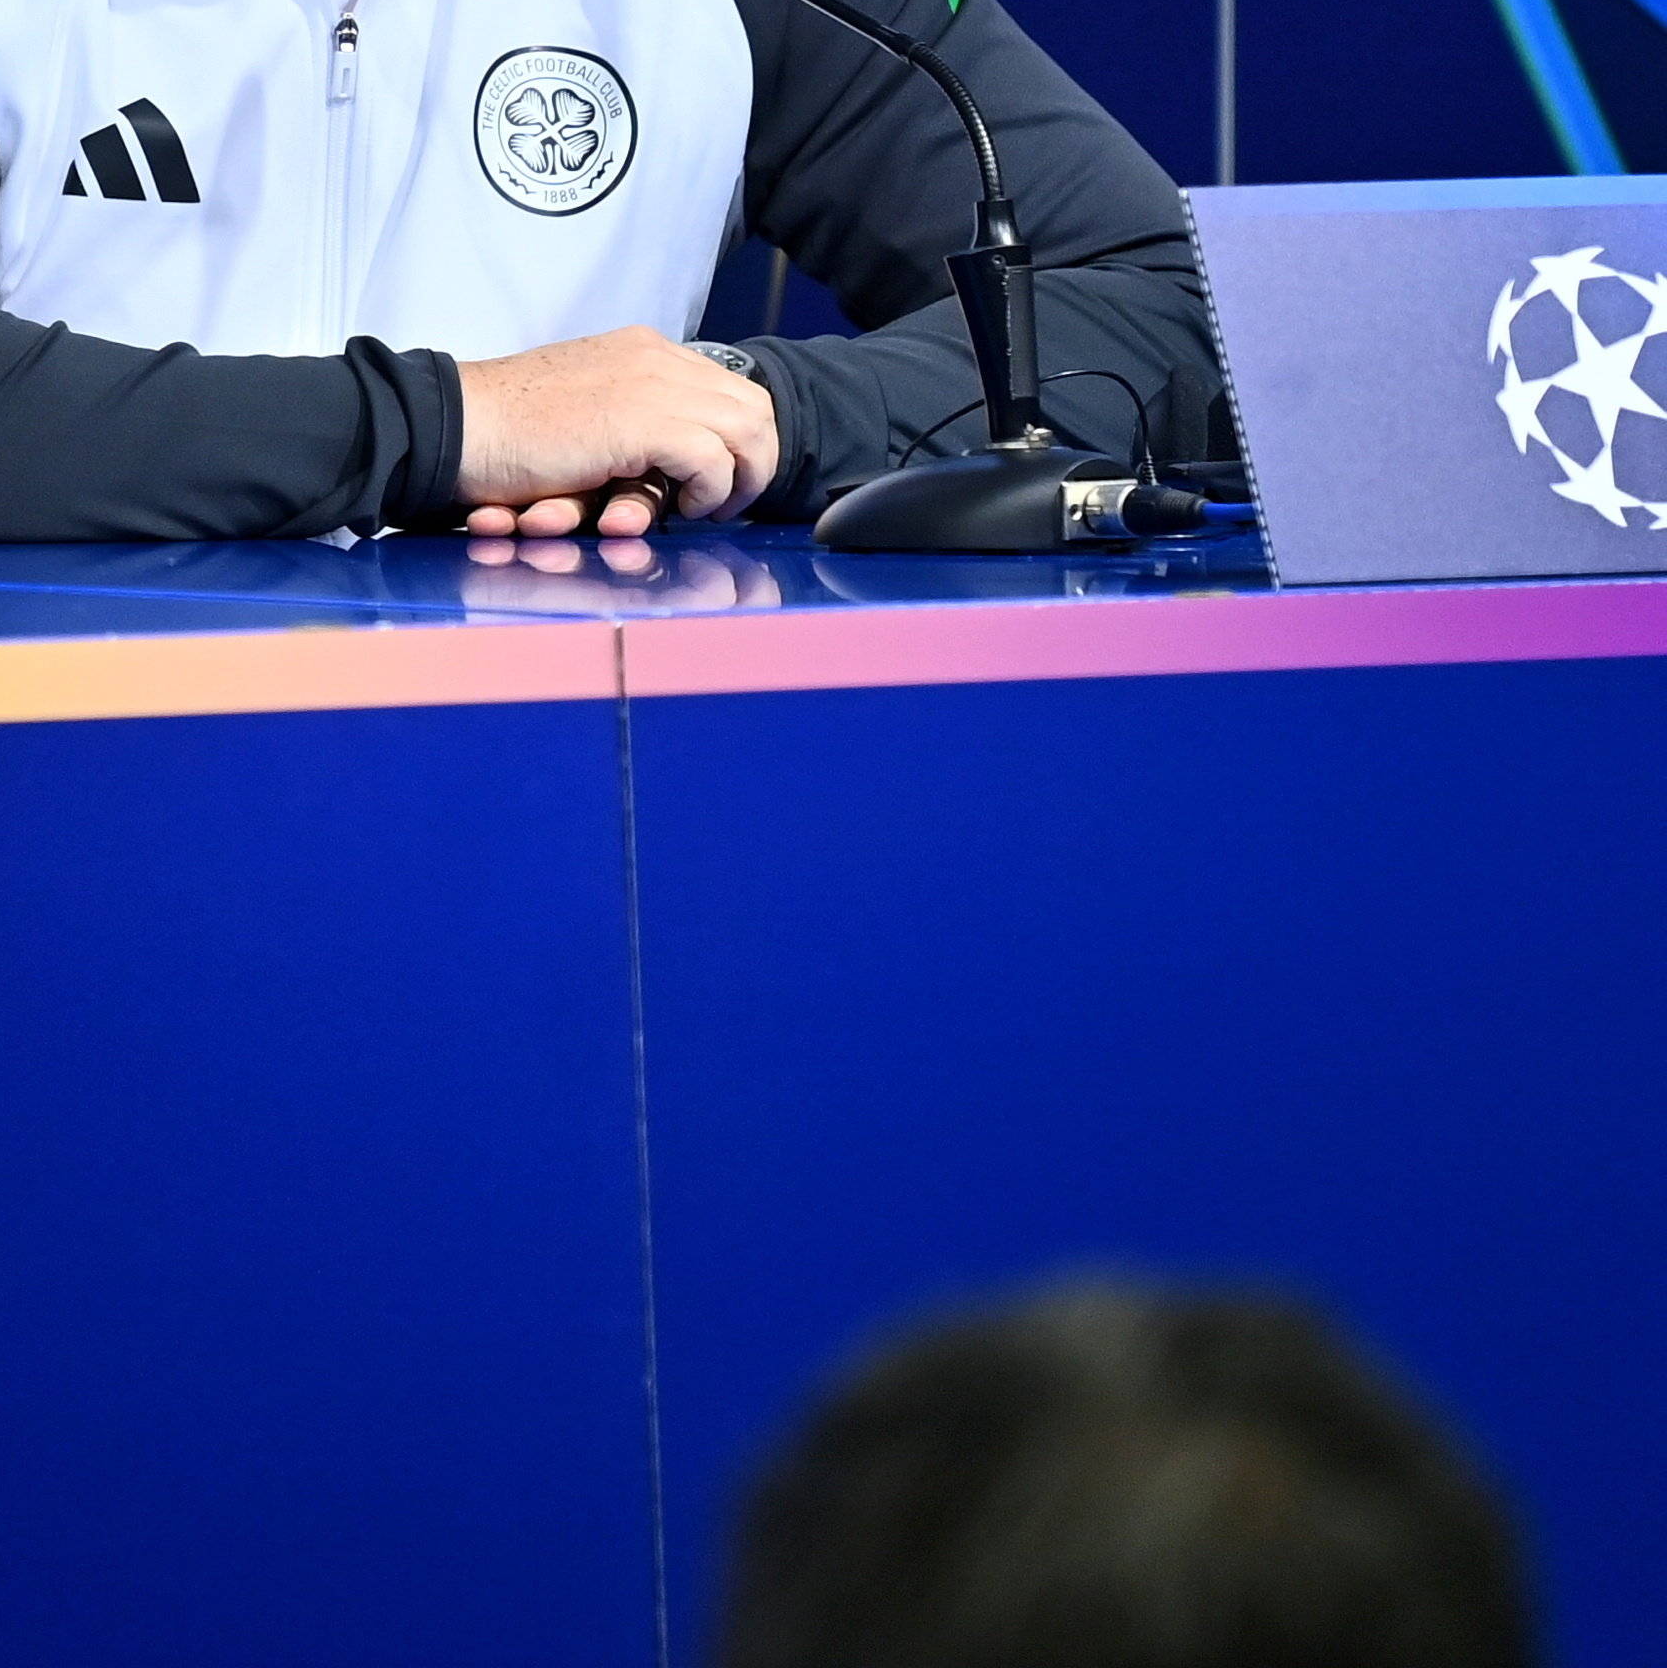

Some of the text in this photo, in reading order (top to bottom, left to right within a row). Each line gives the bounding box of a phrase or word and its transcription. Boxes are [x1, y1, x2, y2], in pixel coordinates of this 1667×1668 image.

[482, 58, 622, 130] THE CELTIC FOOTBALL CLUB
[544, 188, 578, 204] 1888
